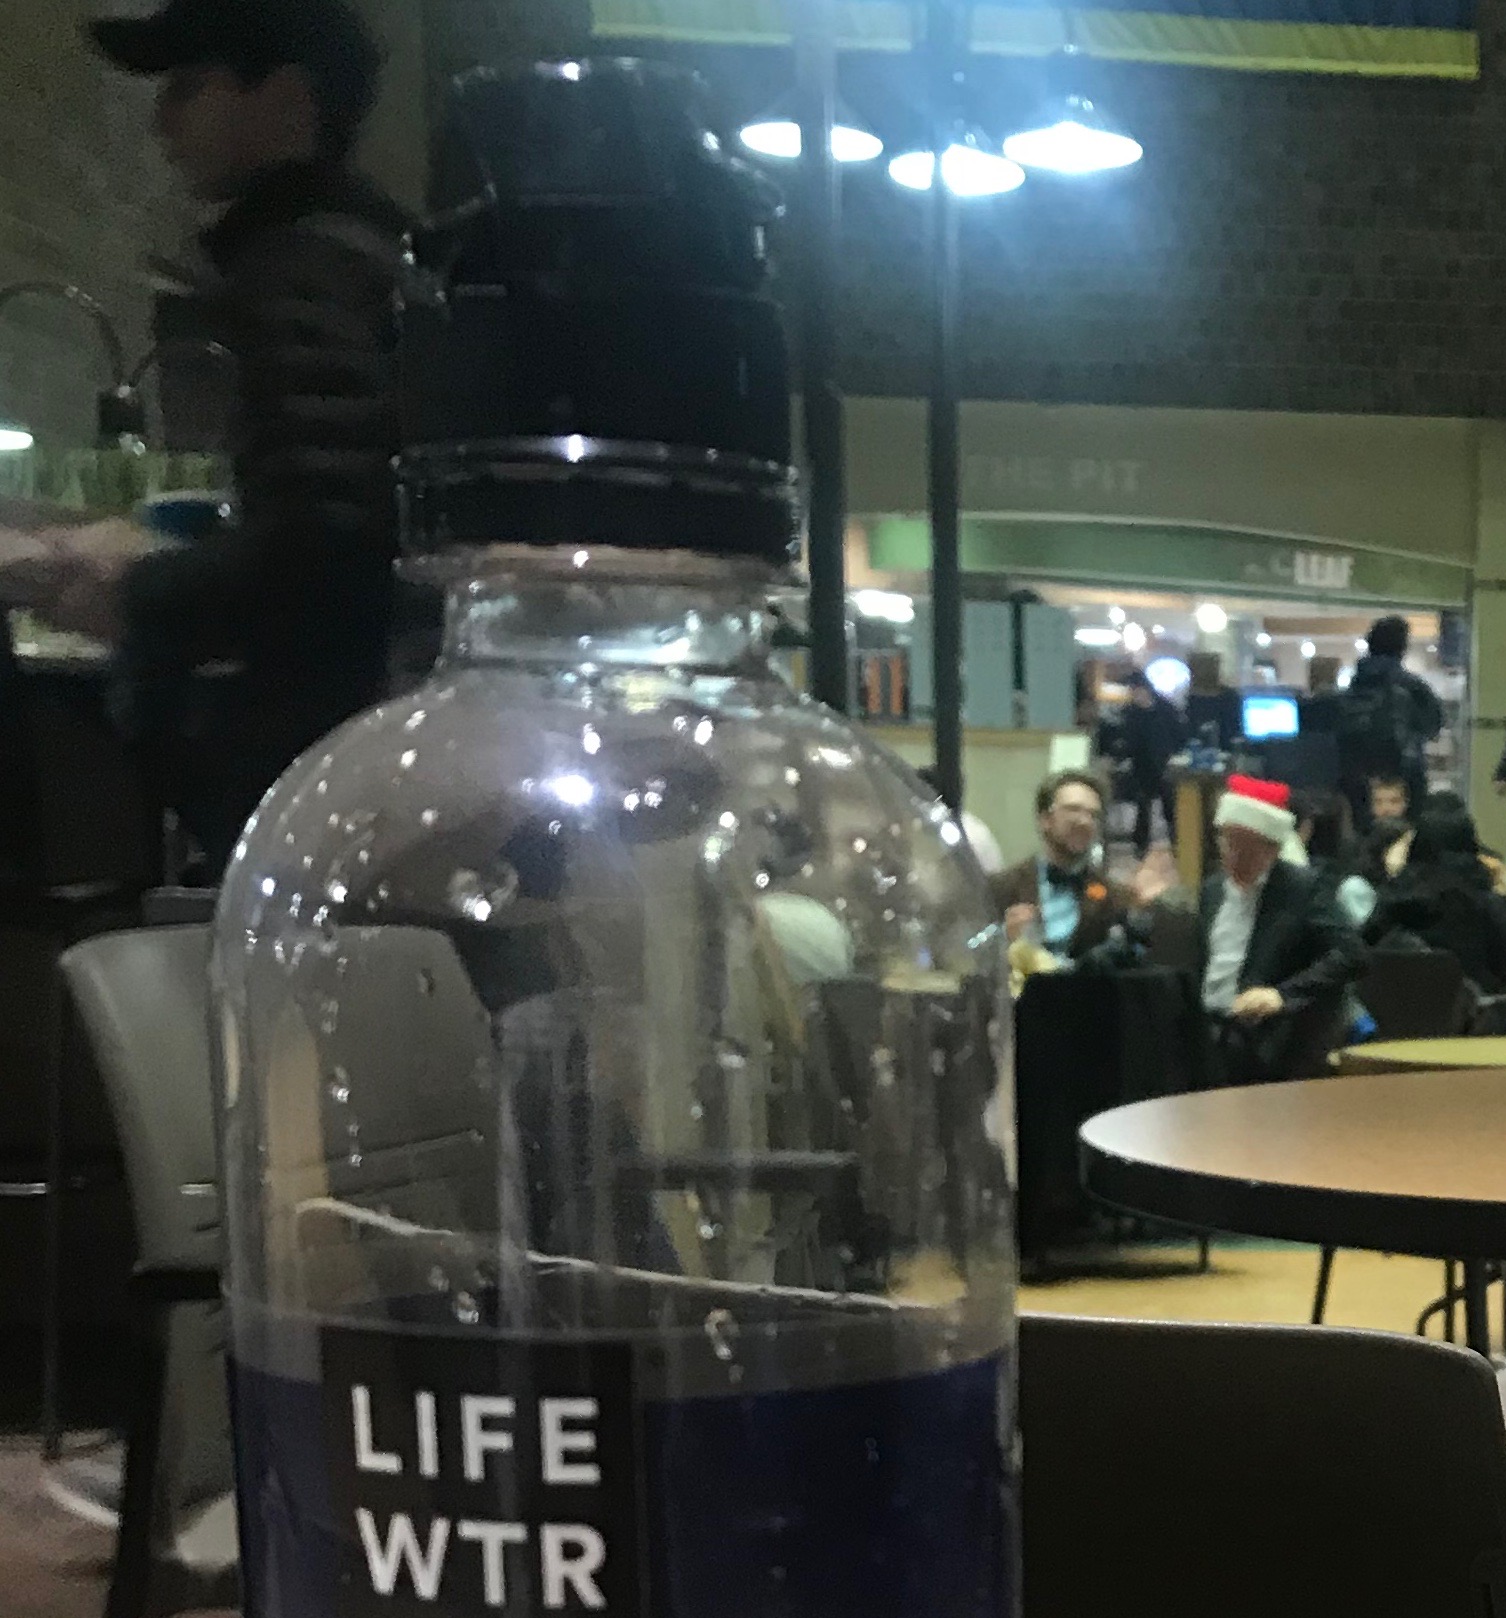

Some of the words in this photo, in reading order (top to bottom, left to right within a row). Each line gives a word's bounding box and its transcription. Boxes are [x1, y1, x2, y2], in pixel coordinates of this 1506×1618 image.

[1069, 456, 1142, 493] PIT
[351, 1382, 601, 1486] LIFE
[354, 1506, 607, 1610] WTR
